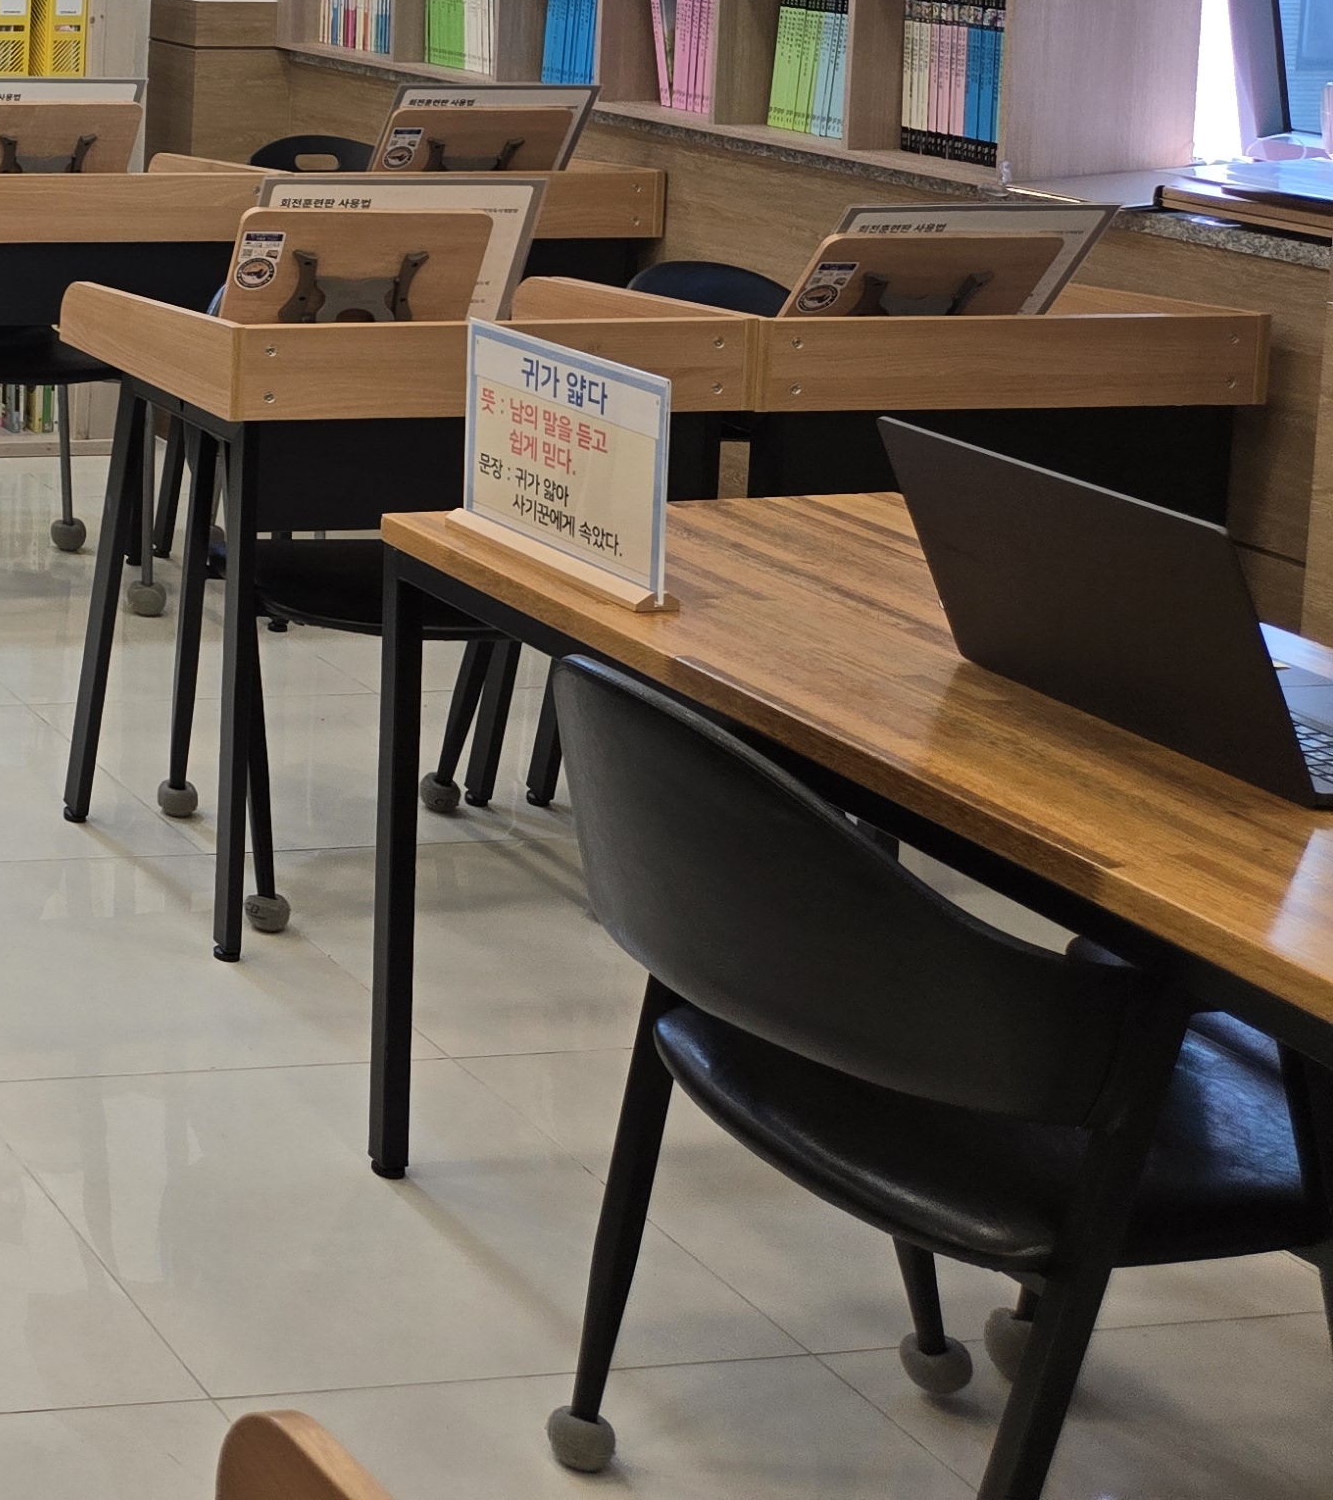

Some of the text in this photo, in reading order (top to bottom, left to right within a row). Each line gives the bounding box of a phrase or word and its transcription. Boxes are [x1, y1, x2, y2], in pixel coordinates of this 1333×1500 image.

[521, 357, 608, 415] 귀가 얇다
[480, 386, 496, 415] 뜻
[509, 398, 538, 431] 남의
[543, 407, 573, 443] 말을
[575, 421, 608, 454] 듣고
[478, 453, 502, 480] 문장
[515, 466, 540, 496] 귀가
[543, 477, 569, 508] 얇아
[509, 428, 576, 476] 쉽게 믿다.
[512, 493, 623, 557] 사기꾼에게 속았다.
